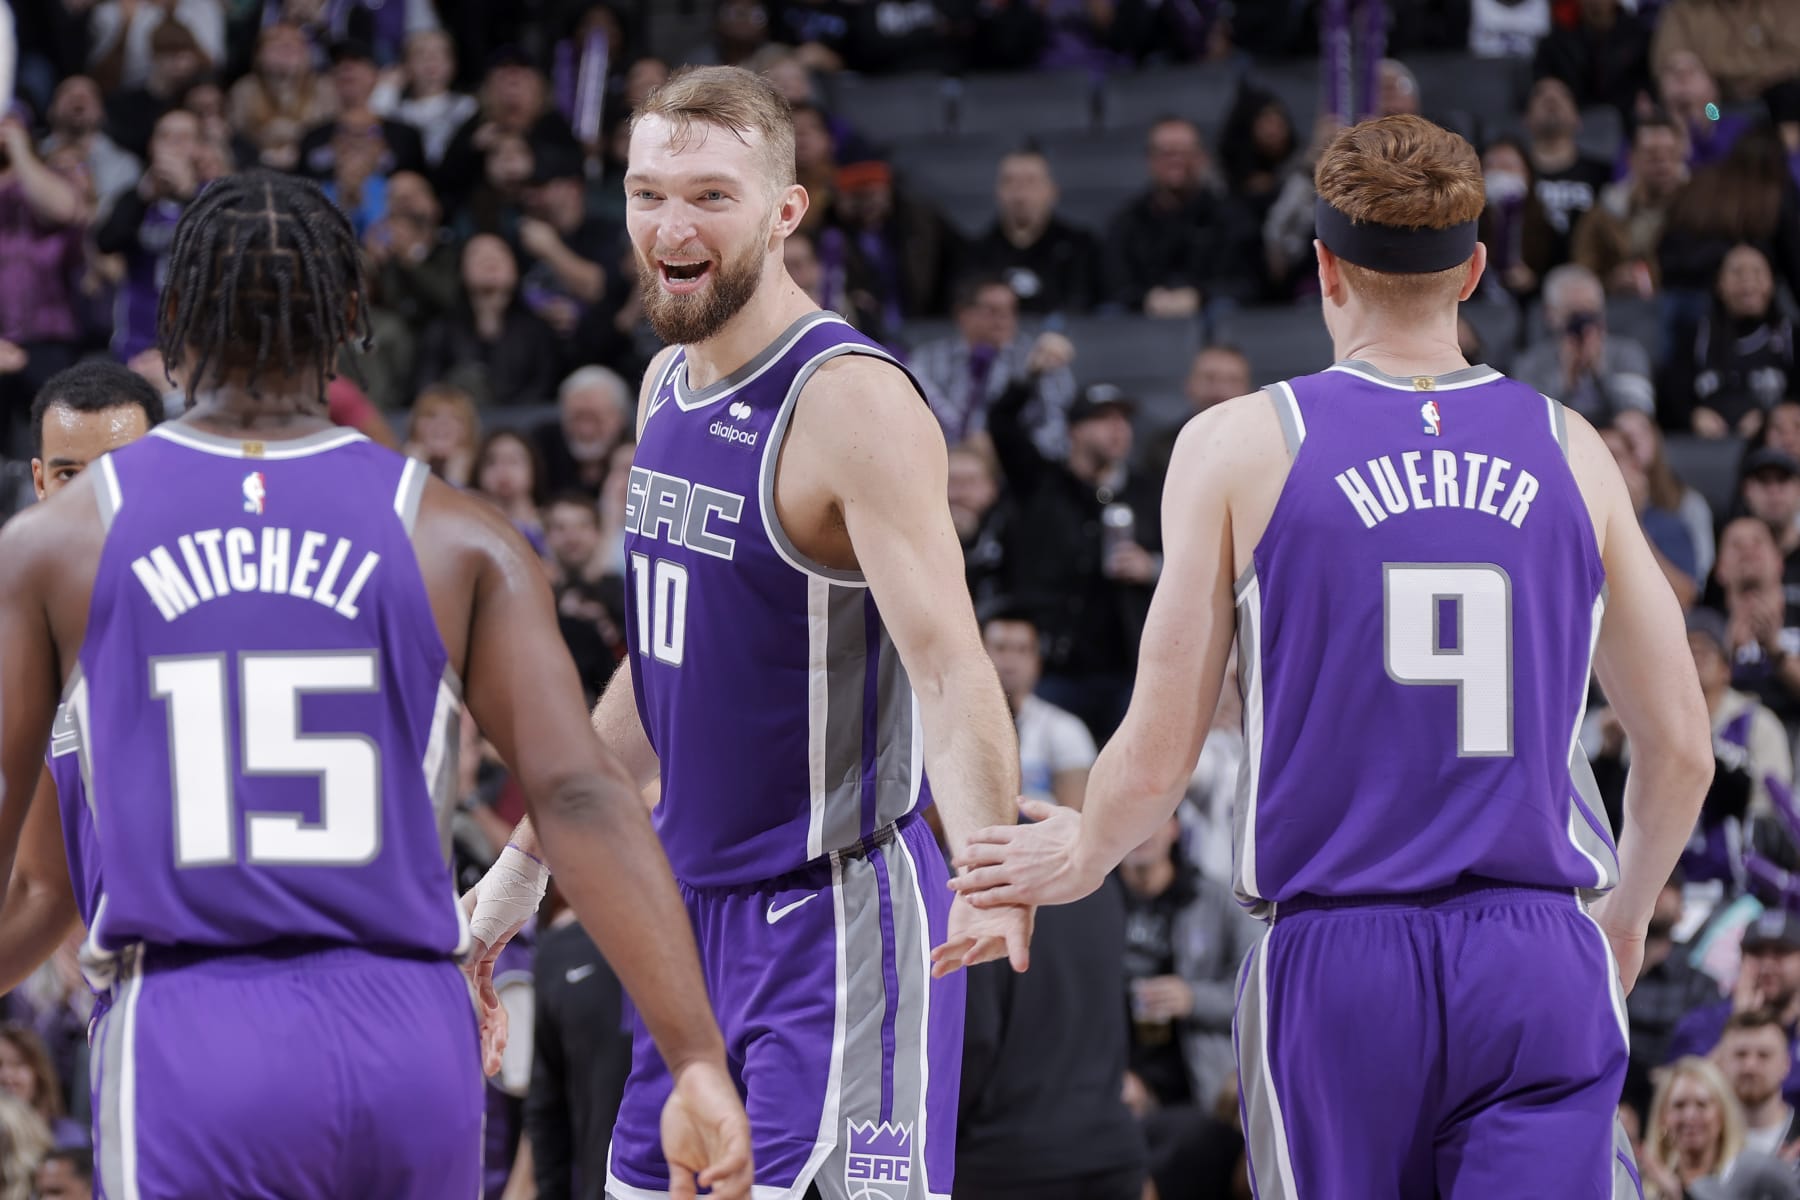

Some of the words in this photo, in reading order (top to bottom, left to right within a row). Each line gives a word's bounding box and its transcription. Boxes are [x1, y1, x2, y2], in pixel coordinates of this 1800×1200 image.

[709, 421, 758, 445] dialpad
[625, 466, 745, 560] SAC
[1335, 450, 1539, 528] HUERTER
[131, 527, 380, 622] MITCHELL
[631, 551, 689, 667] 10
[1382, 562, 1514, 757] 9
[149, 648, 382, 869] 15
[848, 1157, 909, 1181] SAC
